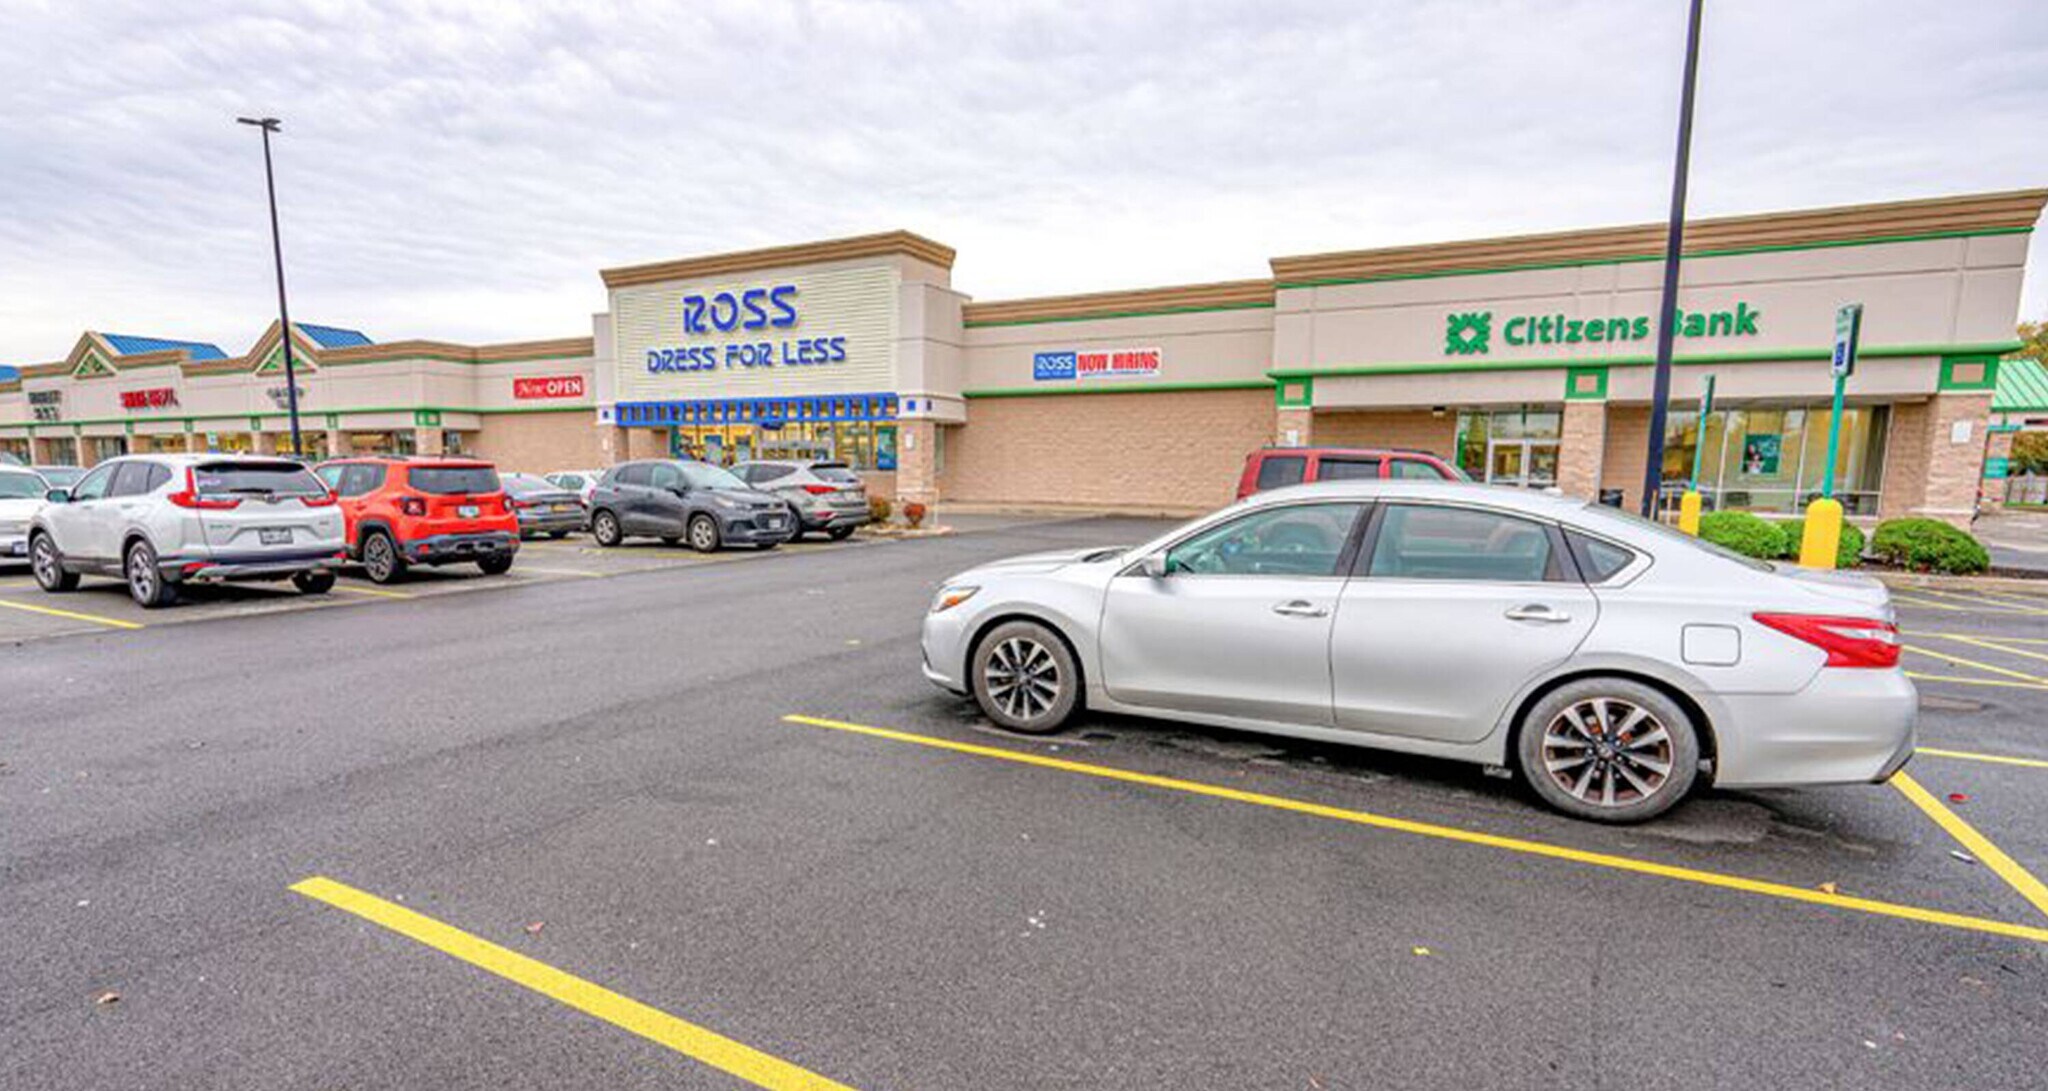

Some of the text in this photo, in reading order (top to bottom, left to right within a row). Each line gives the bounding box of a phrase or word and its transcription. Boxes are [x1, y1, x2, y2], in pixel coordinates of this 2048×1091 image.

[683, 285, 796, 333] ROSS
[1503, 314, 1650, 346] Citizens
[648, 337, 846, 373] DRESS FOR LESS
[1037, 356, 1074, 370] ROSS
[1078, 354, 1109, 371] NOW
[546, 379, 581, 395] OPEN
